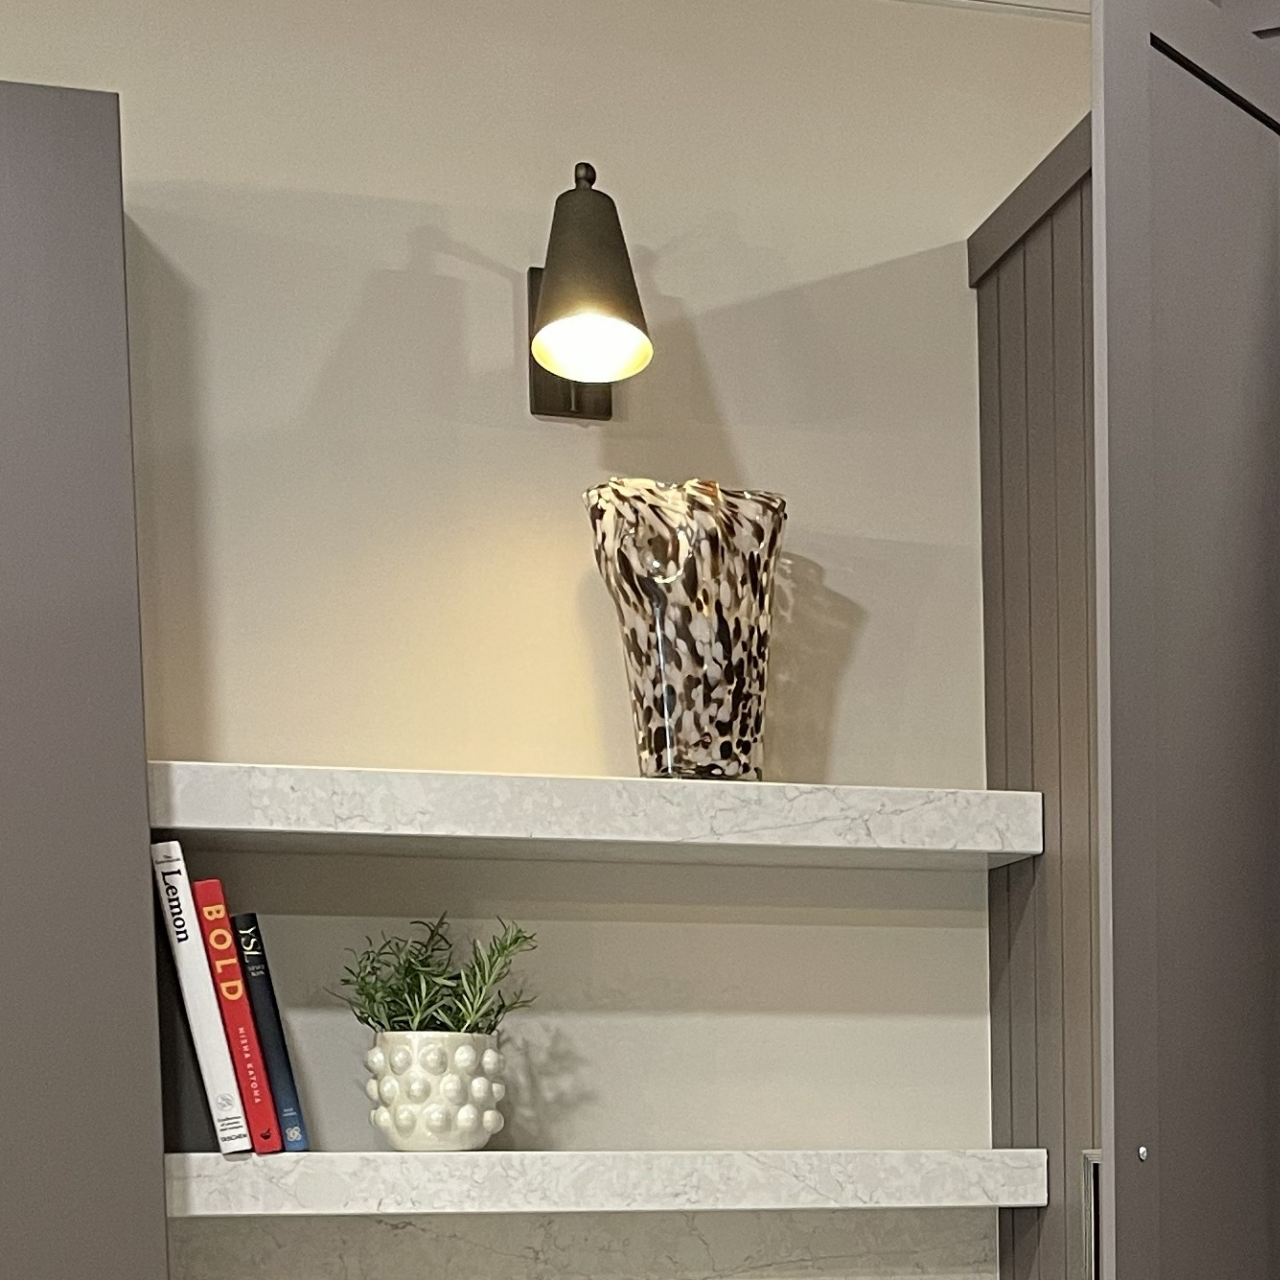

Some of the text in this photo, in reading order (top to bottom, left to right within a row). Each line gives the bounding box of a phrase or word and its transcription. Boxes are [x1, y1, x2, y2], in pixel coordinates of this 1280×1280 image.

[160, 868, 190, 943] Lemon
[202, 904, 244, 1002] BOLD
[238, 926, 263, 964] YSL
